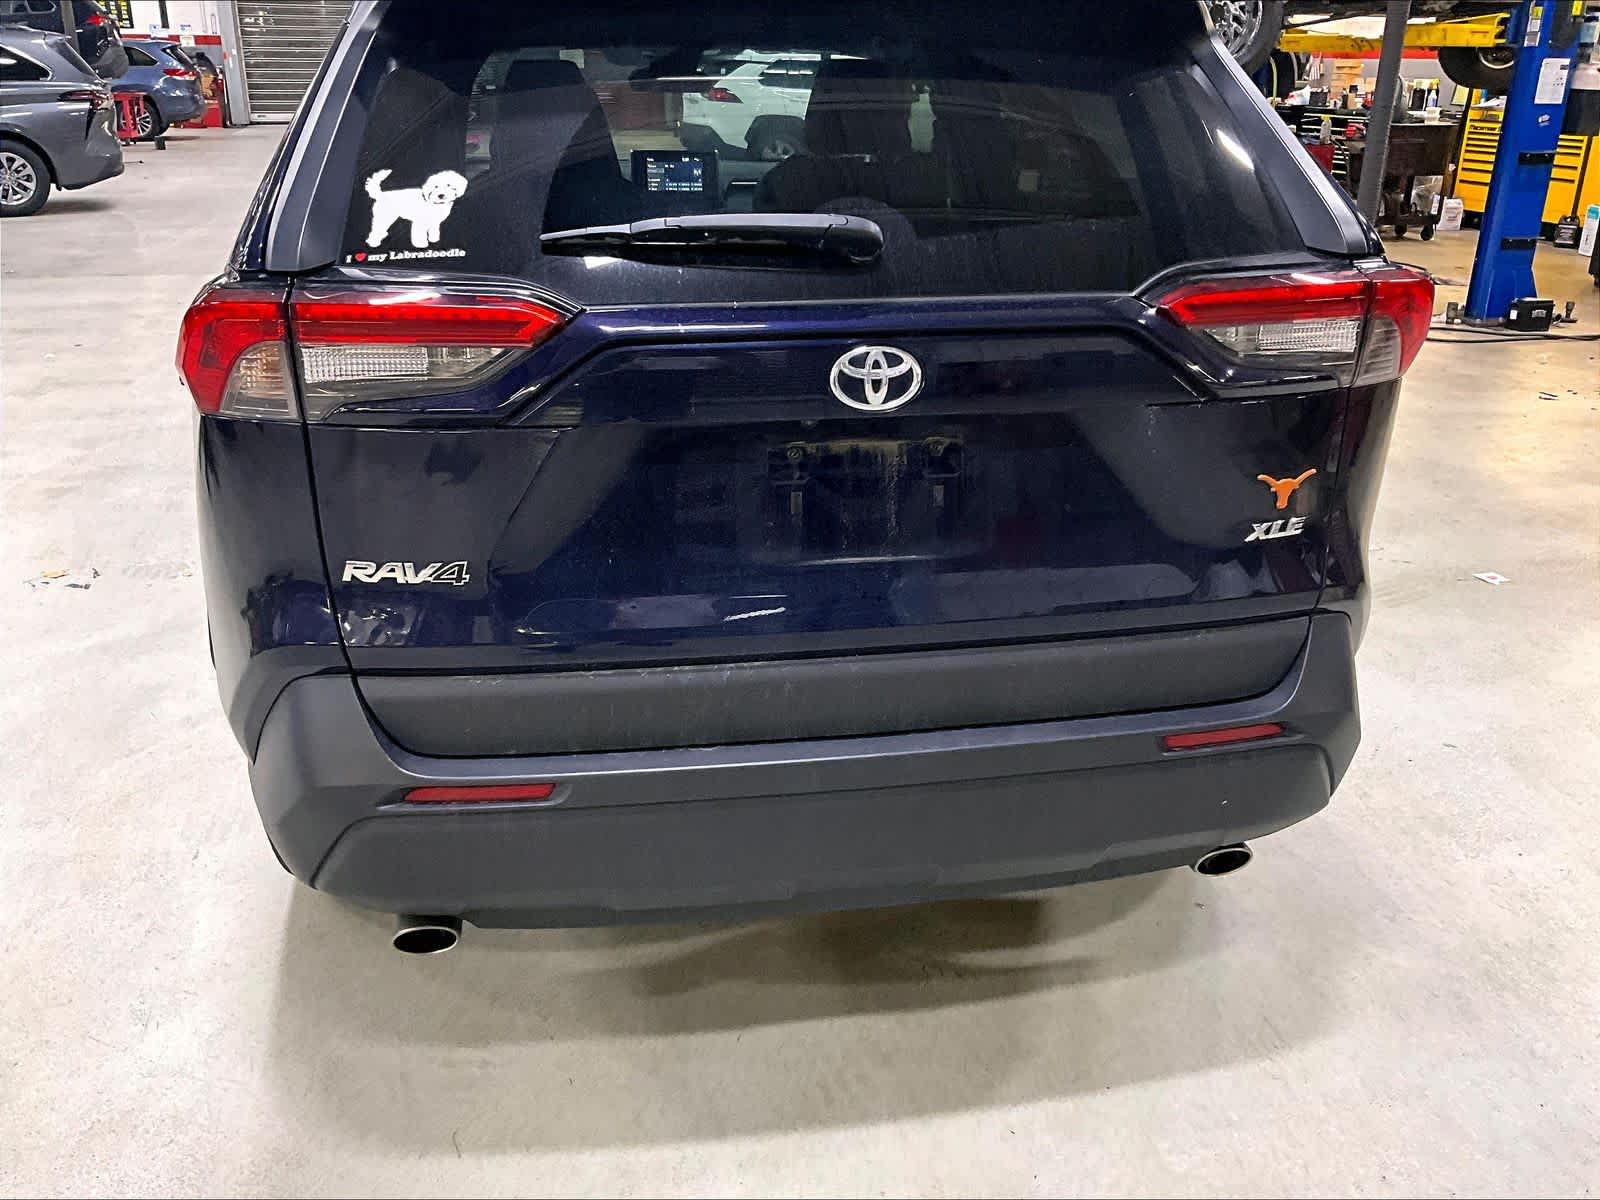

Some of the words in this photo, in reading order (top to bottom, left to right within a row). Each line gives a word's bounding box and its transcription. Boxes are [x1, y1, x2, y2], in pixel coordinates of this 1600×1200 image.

[346, 254, 352, 263] I
[367, 254, 388, 262] my
[389, 248, 466, 260] Labradoodle
[1244, 516, 1308, 542] XLE
[342, 560, 470, 586] RAV4
